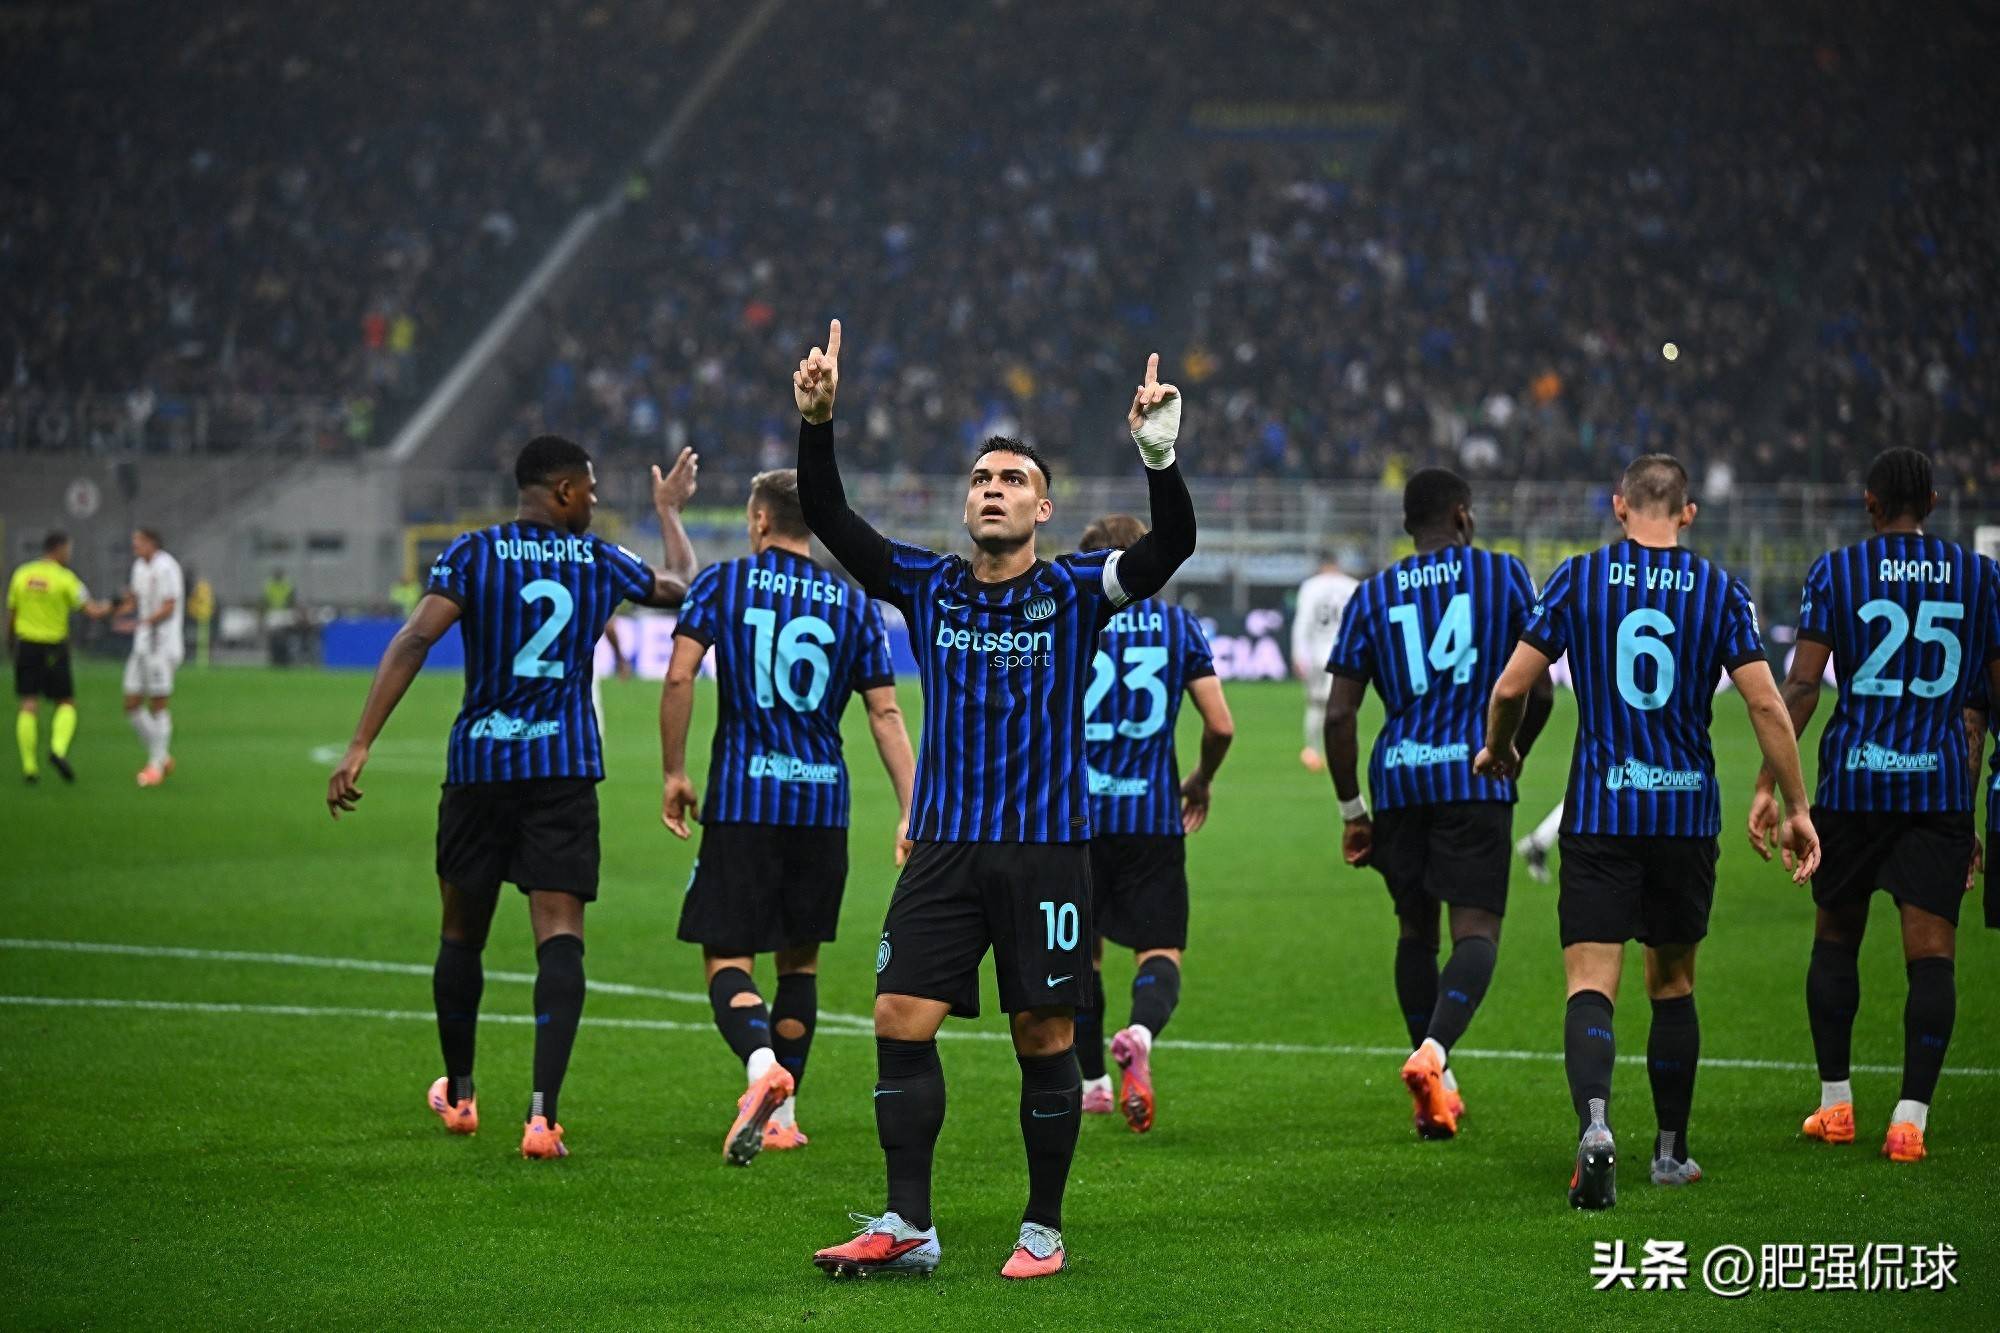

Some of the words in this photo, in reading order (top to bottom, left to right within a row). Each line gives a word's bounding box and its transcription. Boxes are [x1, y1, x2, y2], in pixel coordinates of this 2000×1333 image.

[495, 539, 595, 563] DUMFRIES
[1396, 560, 1462, 591] BONNY
[1879, 558, 1951, 584] AKANJI
[747, 568, 843, 606] FRATTESI
[1608, 562, 1636, 587] DE
[1645, 566, 1695, 592] VRIJ
[512, 578, 574, 679] 2
[936, 619, 1052, 652] betsson
[1388, 592, 1478, 696] 14
[1851, 599, 1965, 698] 25
[743, 607, 836, 713] 16
[1616, 608, 1676, 710] 6
[1084, 646, 1170, 741] 23
[1039, 901, 1080, 951] 10
